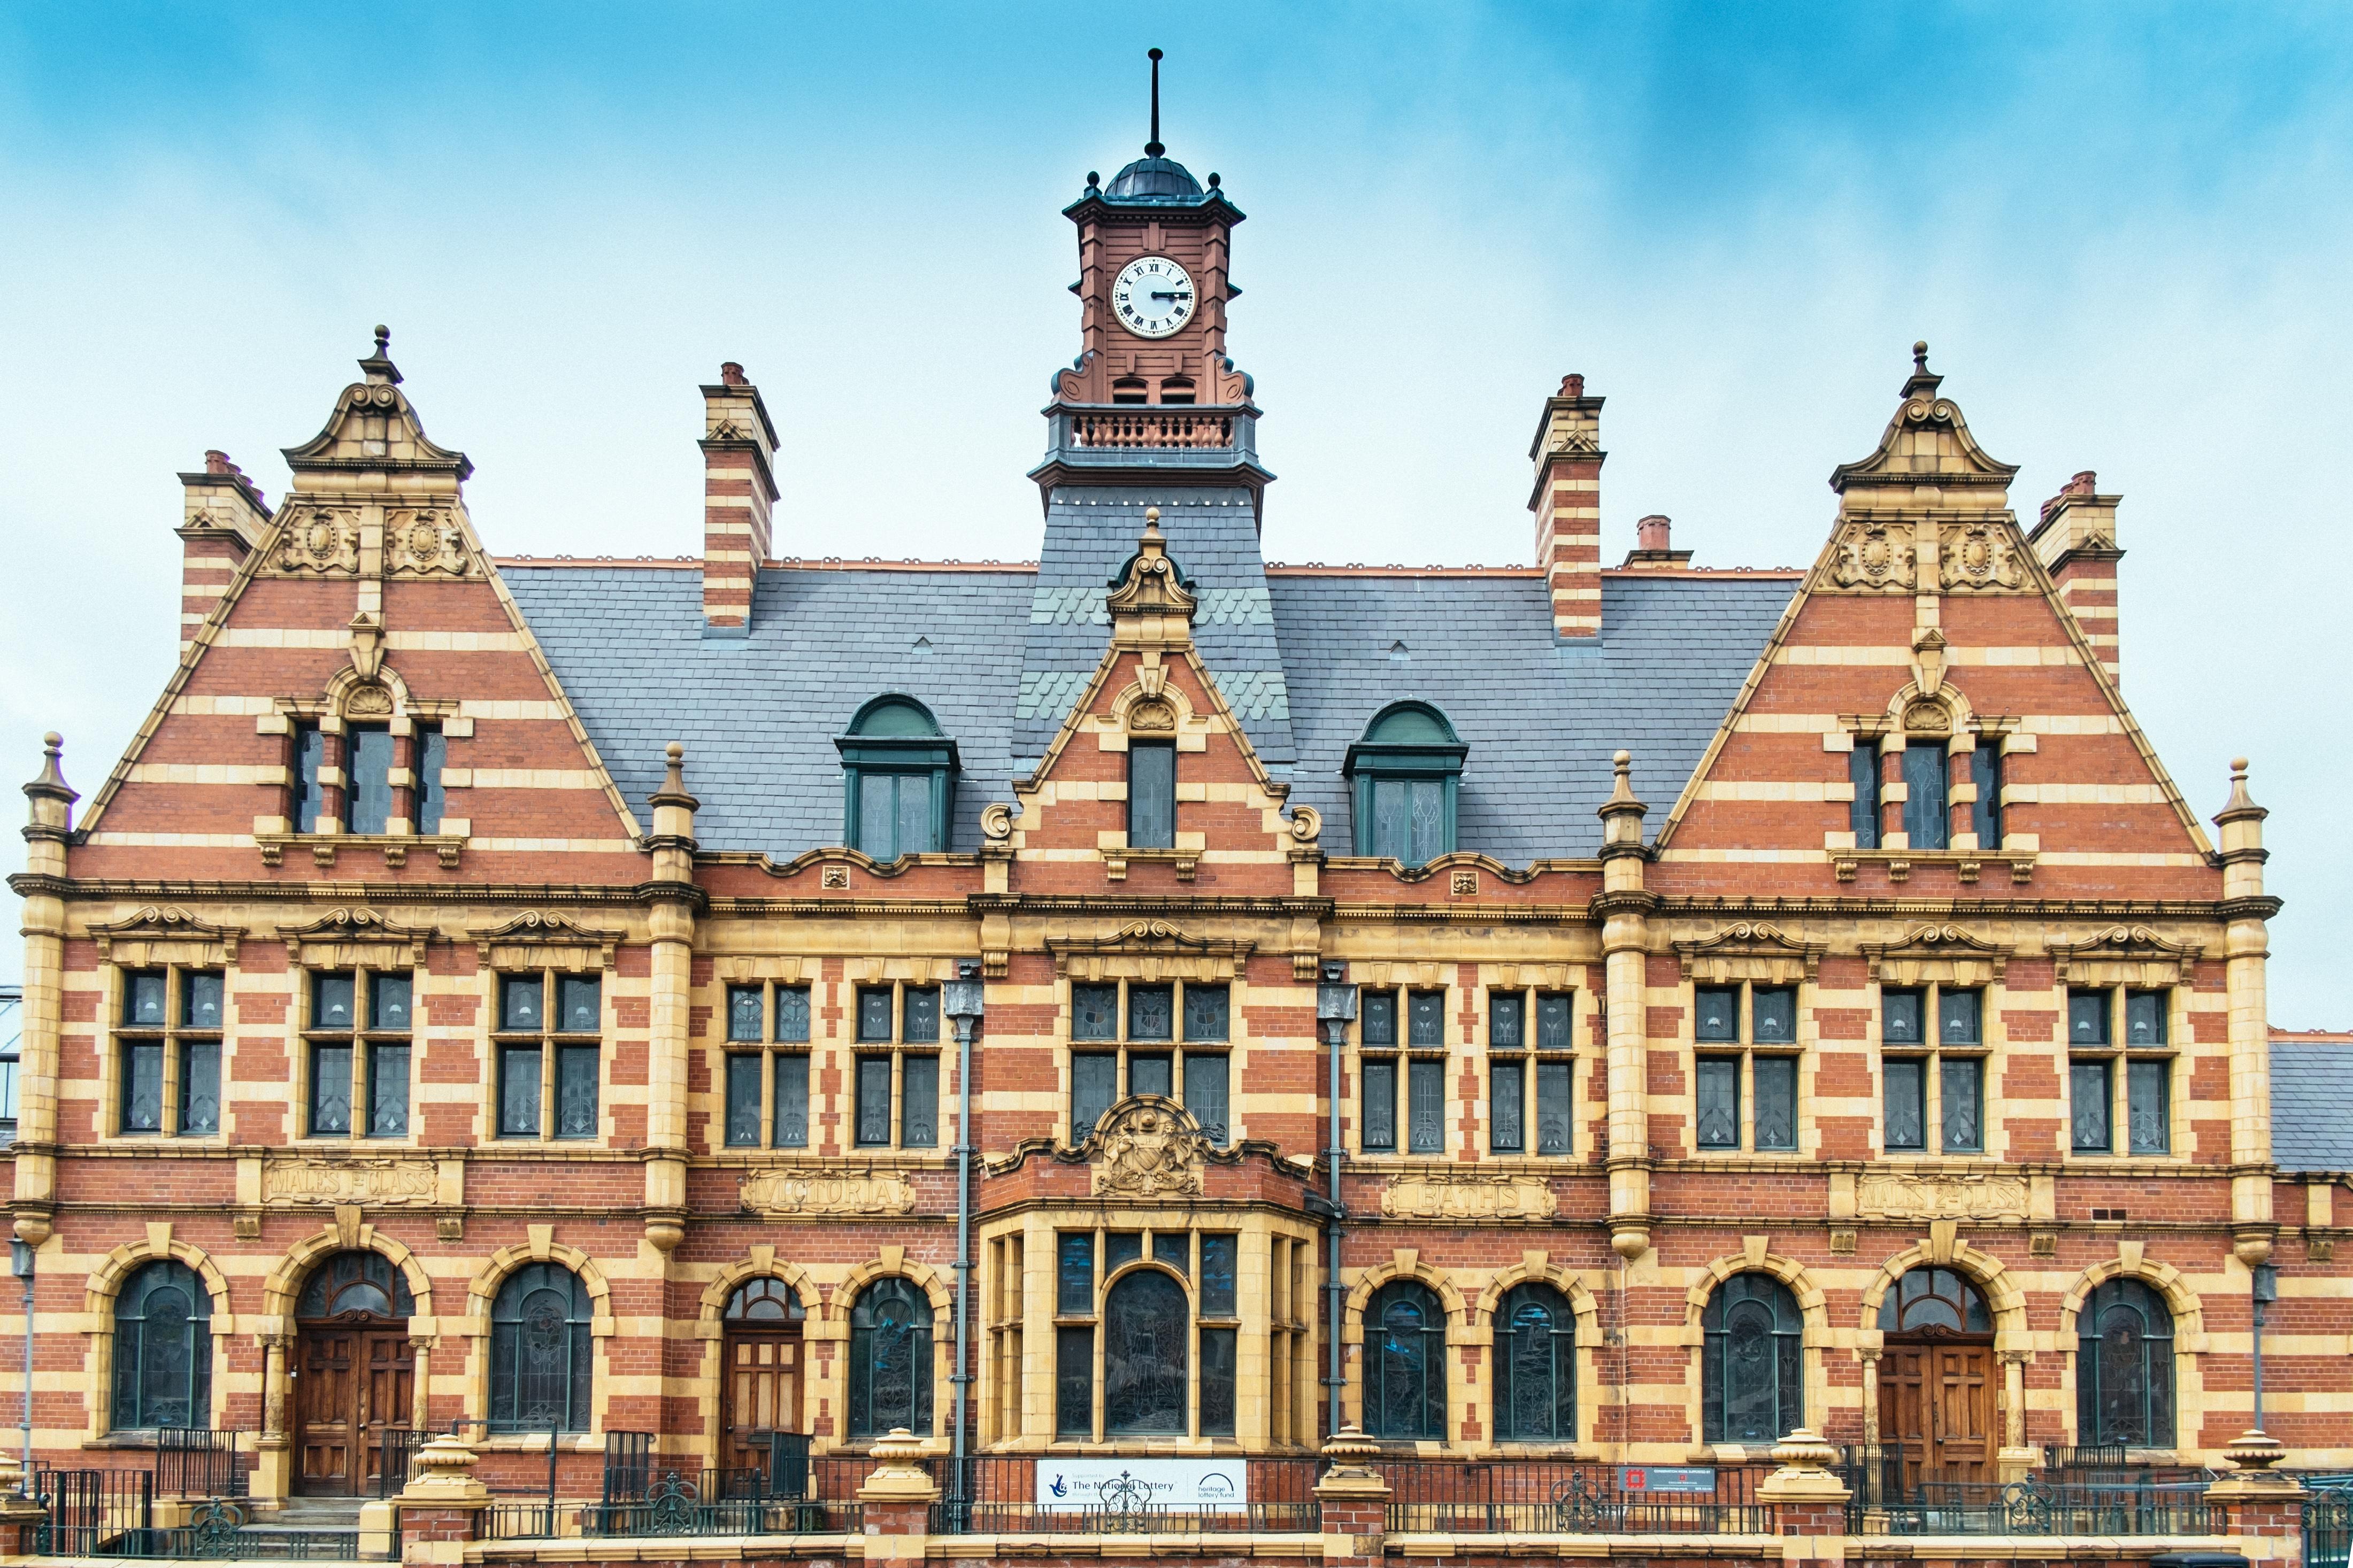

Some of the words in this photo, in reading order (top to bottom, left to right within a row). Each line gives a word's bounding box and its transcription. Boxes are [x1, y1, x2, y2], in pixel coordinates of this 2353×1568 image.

[1134, 266, 1144, 277] XI
[1149, 264, 1159, 272] XII
[1124, 277, 1133, 286] X
[1119, 292, 1129, 301] IX
[1133, 315, 1144, 327] VII
[1150, 320, 1158, 330] VI
[1166, 318, 1173, 327] V
[272, 1170, 340, 1193] MALES
[367, 1170, 430, 1193] CLASS
[760, 1180, 893, 1204] VICTORIA
[1421, 1185, 1519, 1208] BATHS
[1864, 1185, 1927, 1208] MALES
[1960, 1185, 2020, 1208] CLASS
[1072, 1481, 1090, 1489] The
[1138, 1480, 1174, 1492] Lottery
